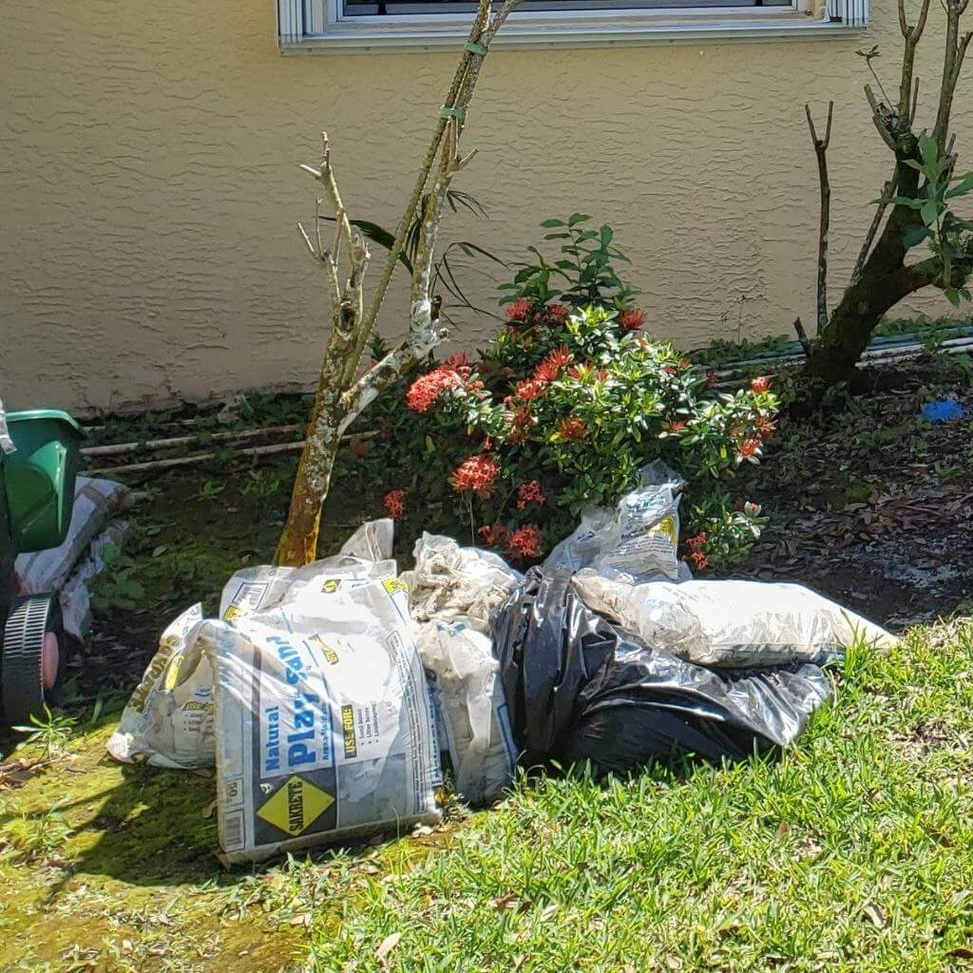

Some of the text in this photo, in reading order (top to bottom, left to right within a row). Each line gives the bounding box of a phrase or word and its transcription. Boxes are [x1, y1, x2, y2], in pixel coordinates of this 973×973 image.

[265, 706, 280, 771] Natural
[287, 690, 320, 767] Play
[342, 707, 355, 754] USE FOR:
[287, 782, 304, 832] SAKRETE
